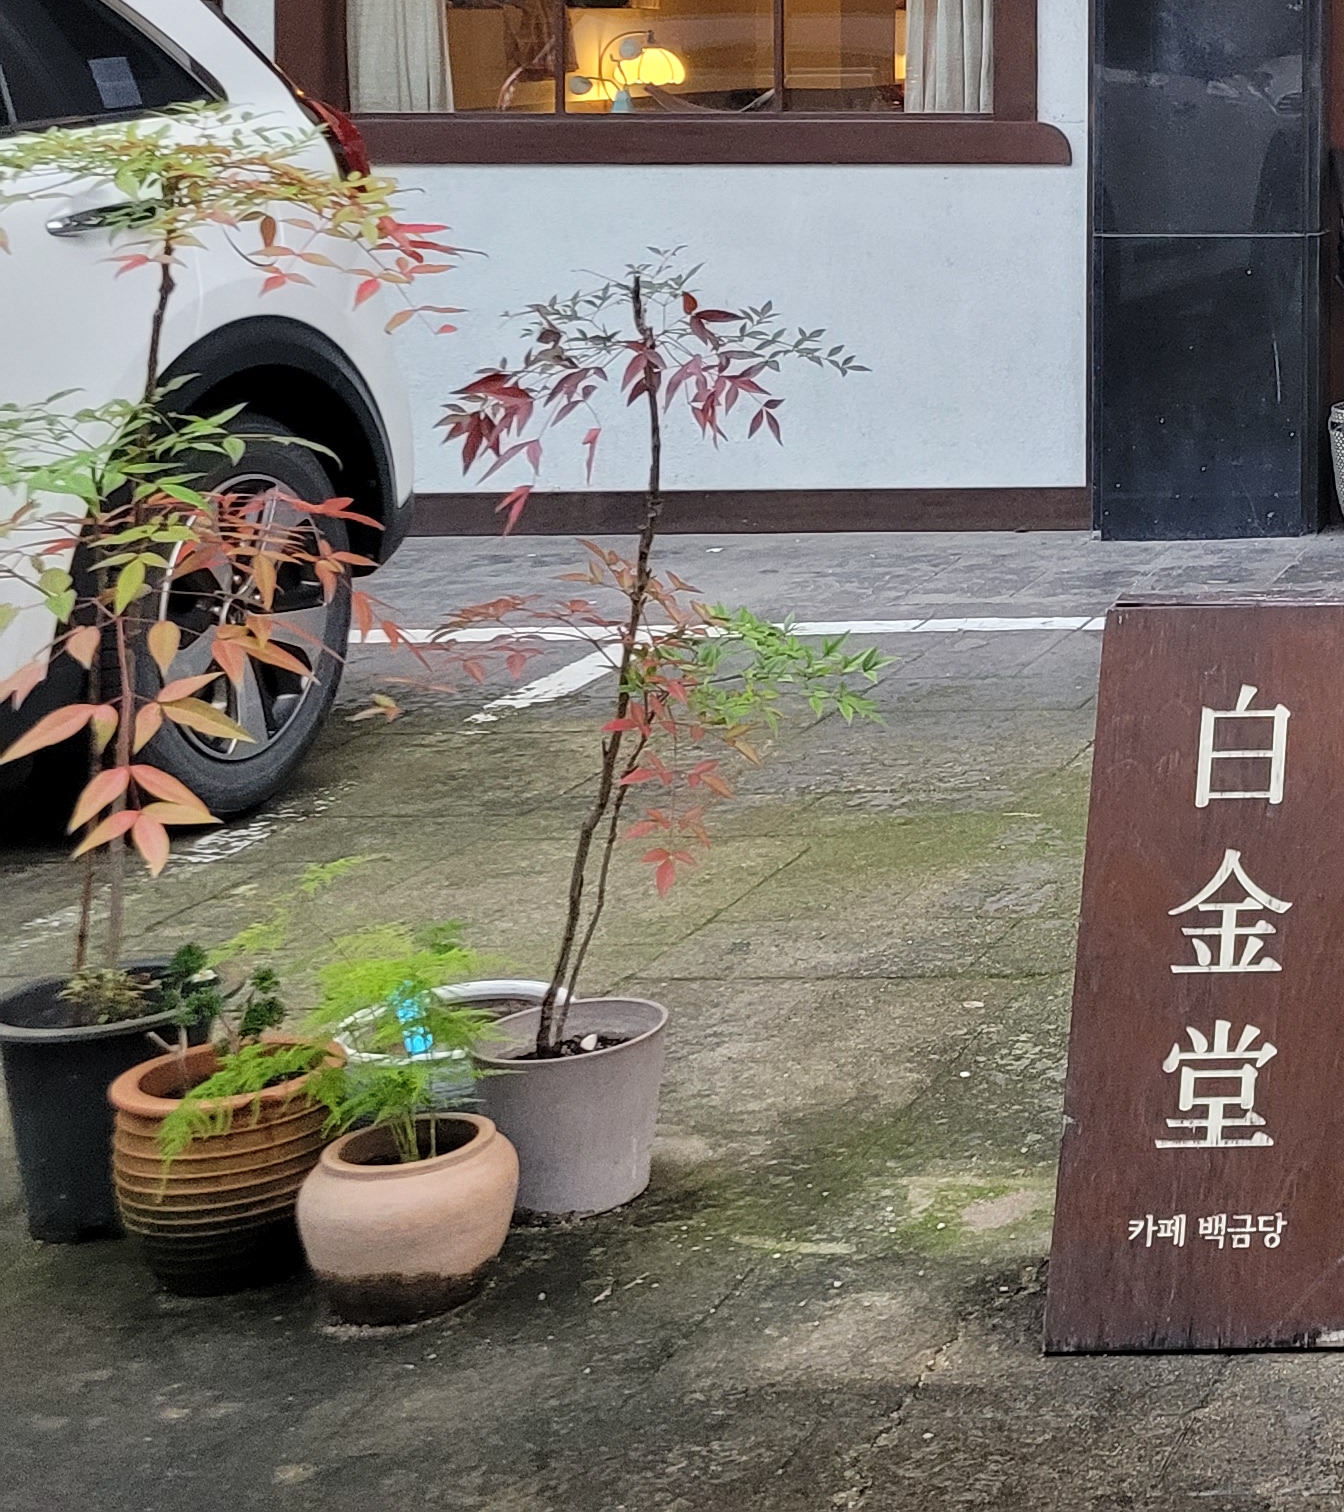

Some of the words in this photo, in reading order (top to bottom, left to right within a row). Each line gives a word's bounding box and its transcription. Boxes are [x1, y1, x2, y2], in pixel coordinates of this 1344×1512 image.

[1154, 683, 1293, 1149] 白金堂
[1128, 1213, 1187, 1248] 카페
[1198, 1212, 1288, 1250] 백금당
